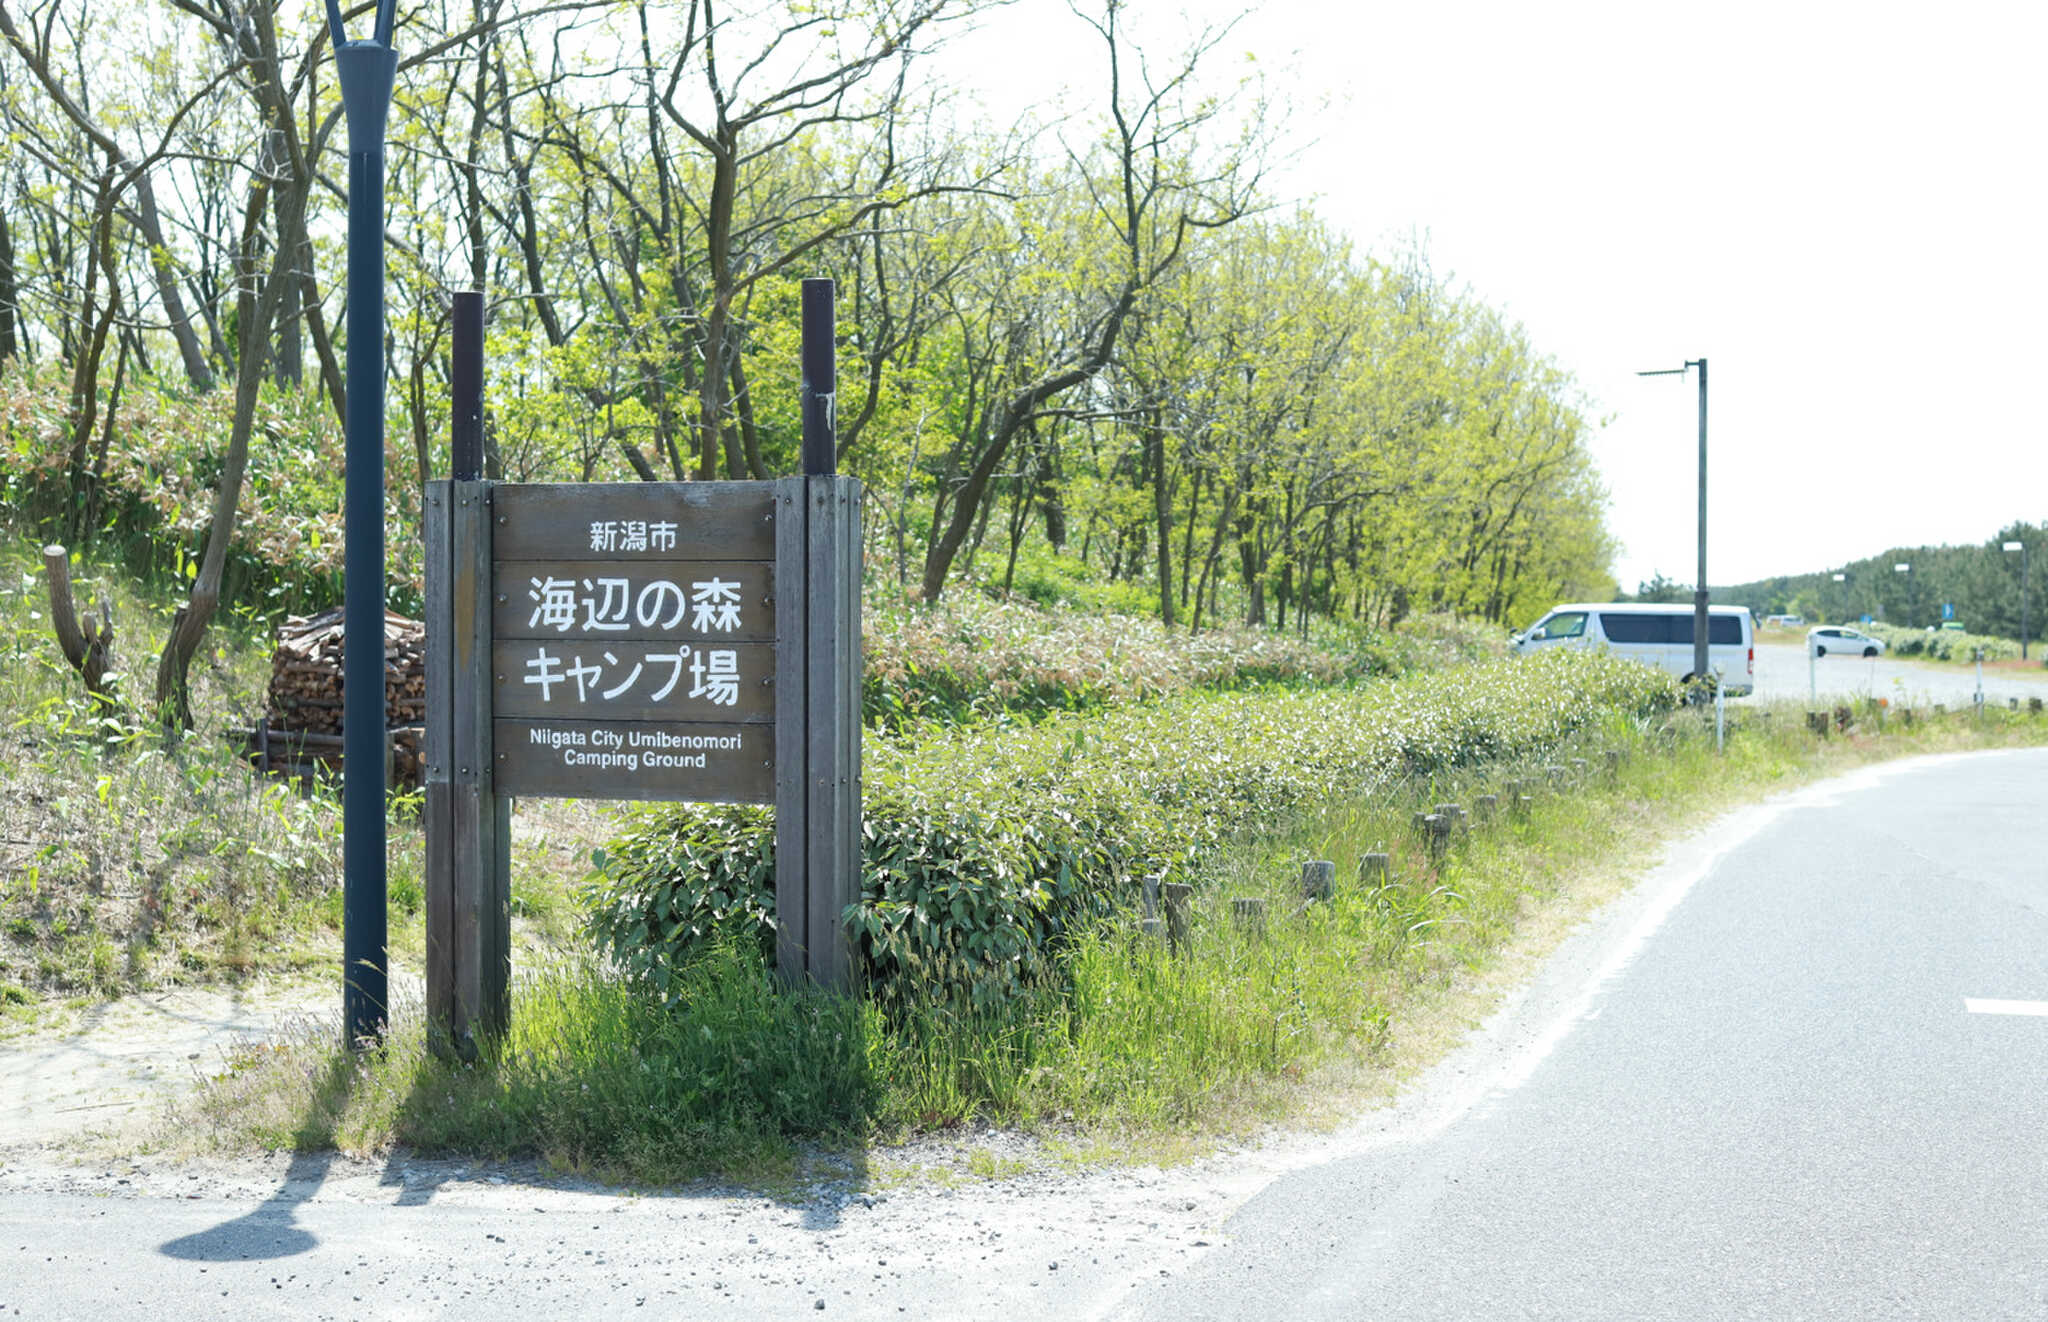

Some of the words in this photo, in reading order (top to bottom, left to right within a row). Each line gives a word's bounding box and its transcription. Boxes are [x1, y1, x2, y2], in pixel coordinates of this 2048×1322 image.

[589, 520, 678, 552] 新潟市
[528, 576, 742, 633] 海辺の森
[523, 645, 741, 706] キャンプ場
[530, 729, 587, 747] Niigata
[591, 730, 624, 749] City
[629, 730, 742, 749] Umibenomori
[564, 749, 638, 770] Camping
[643, 750, 706, 769] Ground
